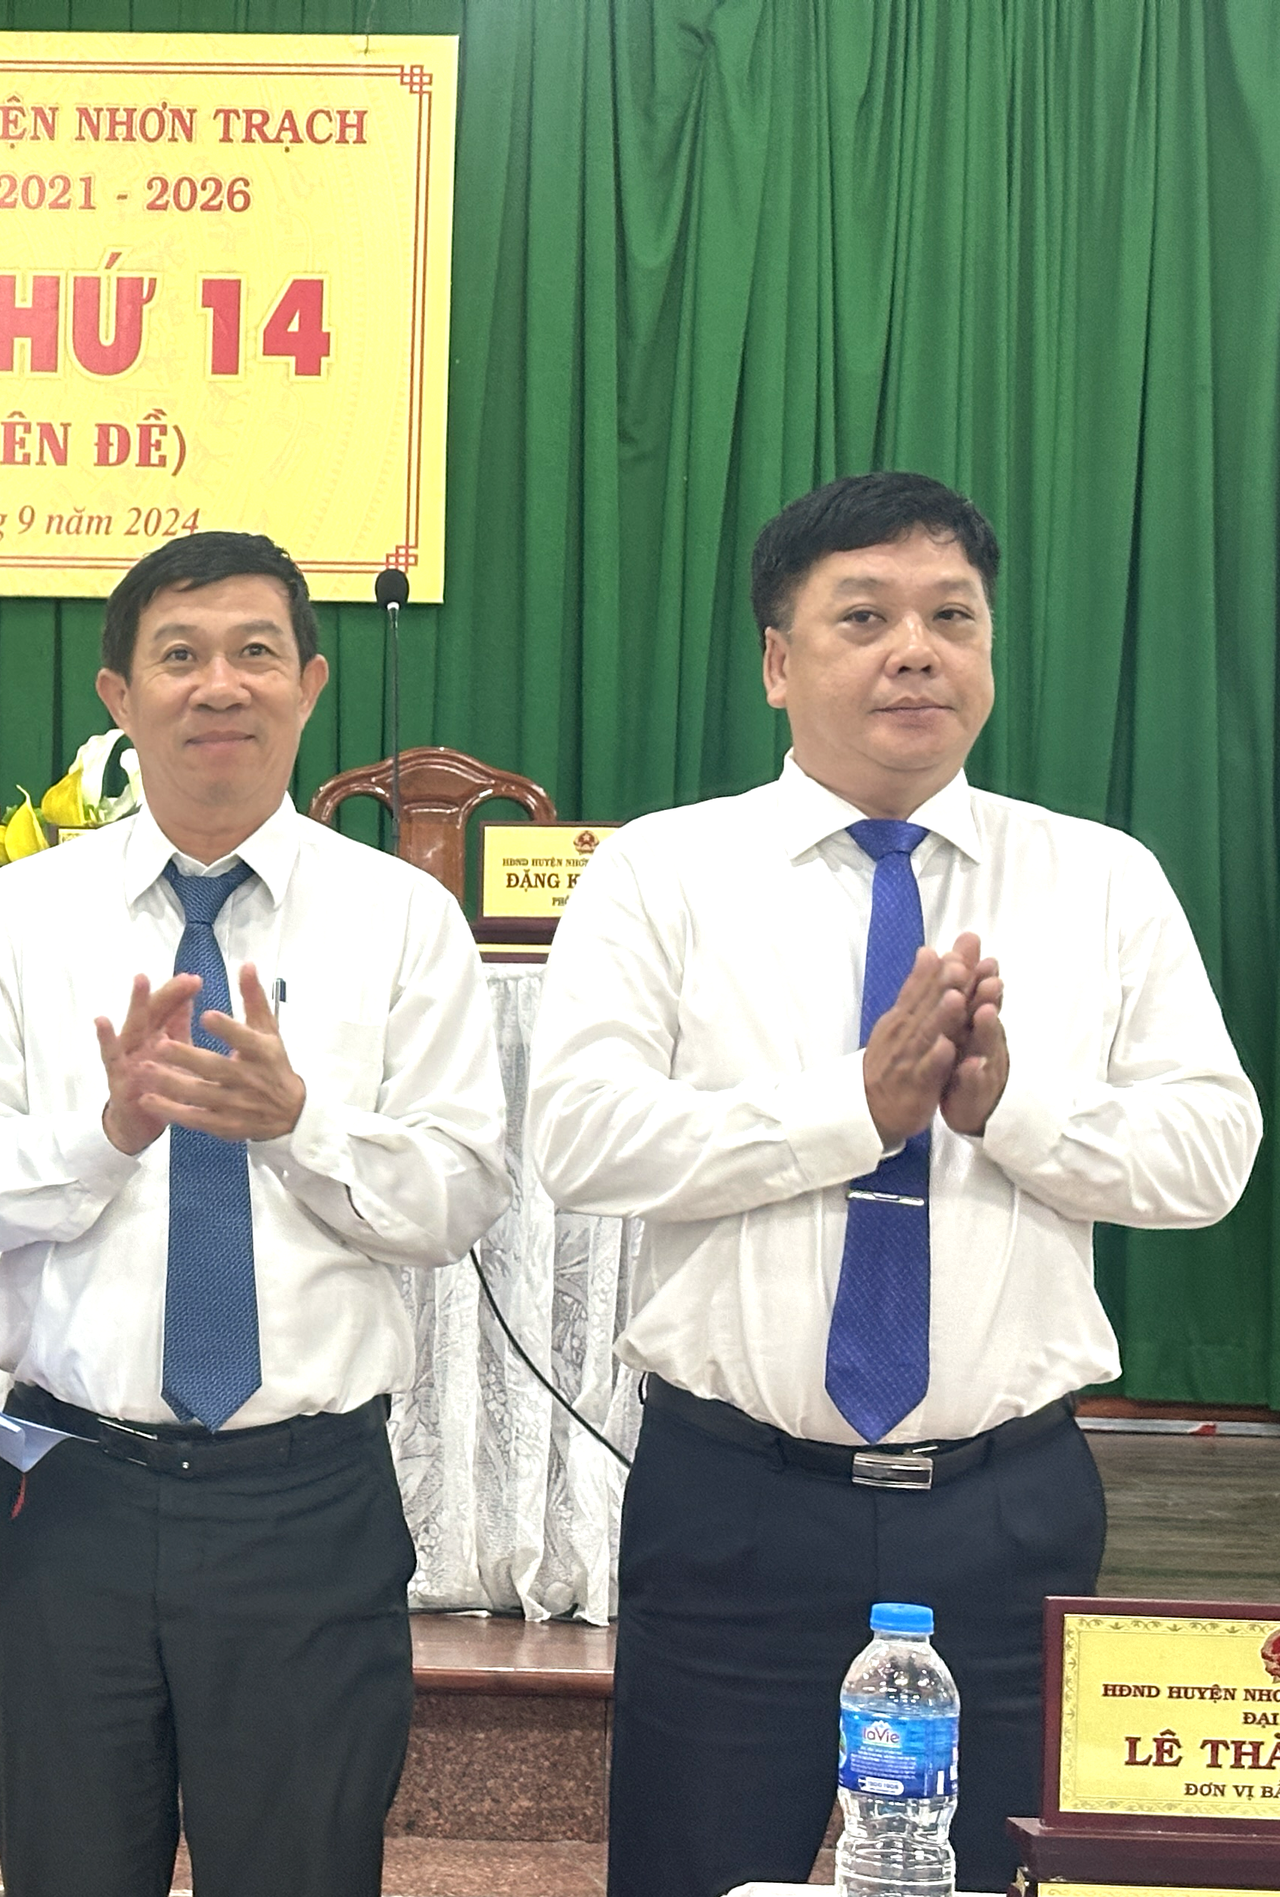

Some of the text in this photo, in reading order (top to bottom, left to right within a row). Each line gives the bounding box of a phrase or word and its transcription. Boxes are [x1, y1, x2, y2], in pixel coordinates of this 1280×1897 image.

[74, 101, 198, 143] NHƠN
[212, 108, 368, 153] TRẠCH
[146, 176, 251, 213] 2026
[201, 278, 331, 377] 14
[93, 408, 187, 477] ĐỀ)
[18, 505, 36, 534] 9
[45, 507, 113, 536] năm
[124, 507, 203, 538] 2024
[506, 869, 561, 892] ĐẶNG
[1102, 1683, 1161, 1698] HĐND
[1167, 1683, 1238, 1704] HUYỆN
[863, 1727, 900, 1744] laVie
[1242, 1711, 1280, 1729] ĐẠI
[1124, 1728, 1183, 1767] LÊ
[1184, 1782, 1280, 1801] ĐƠN VỊ B
